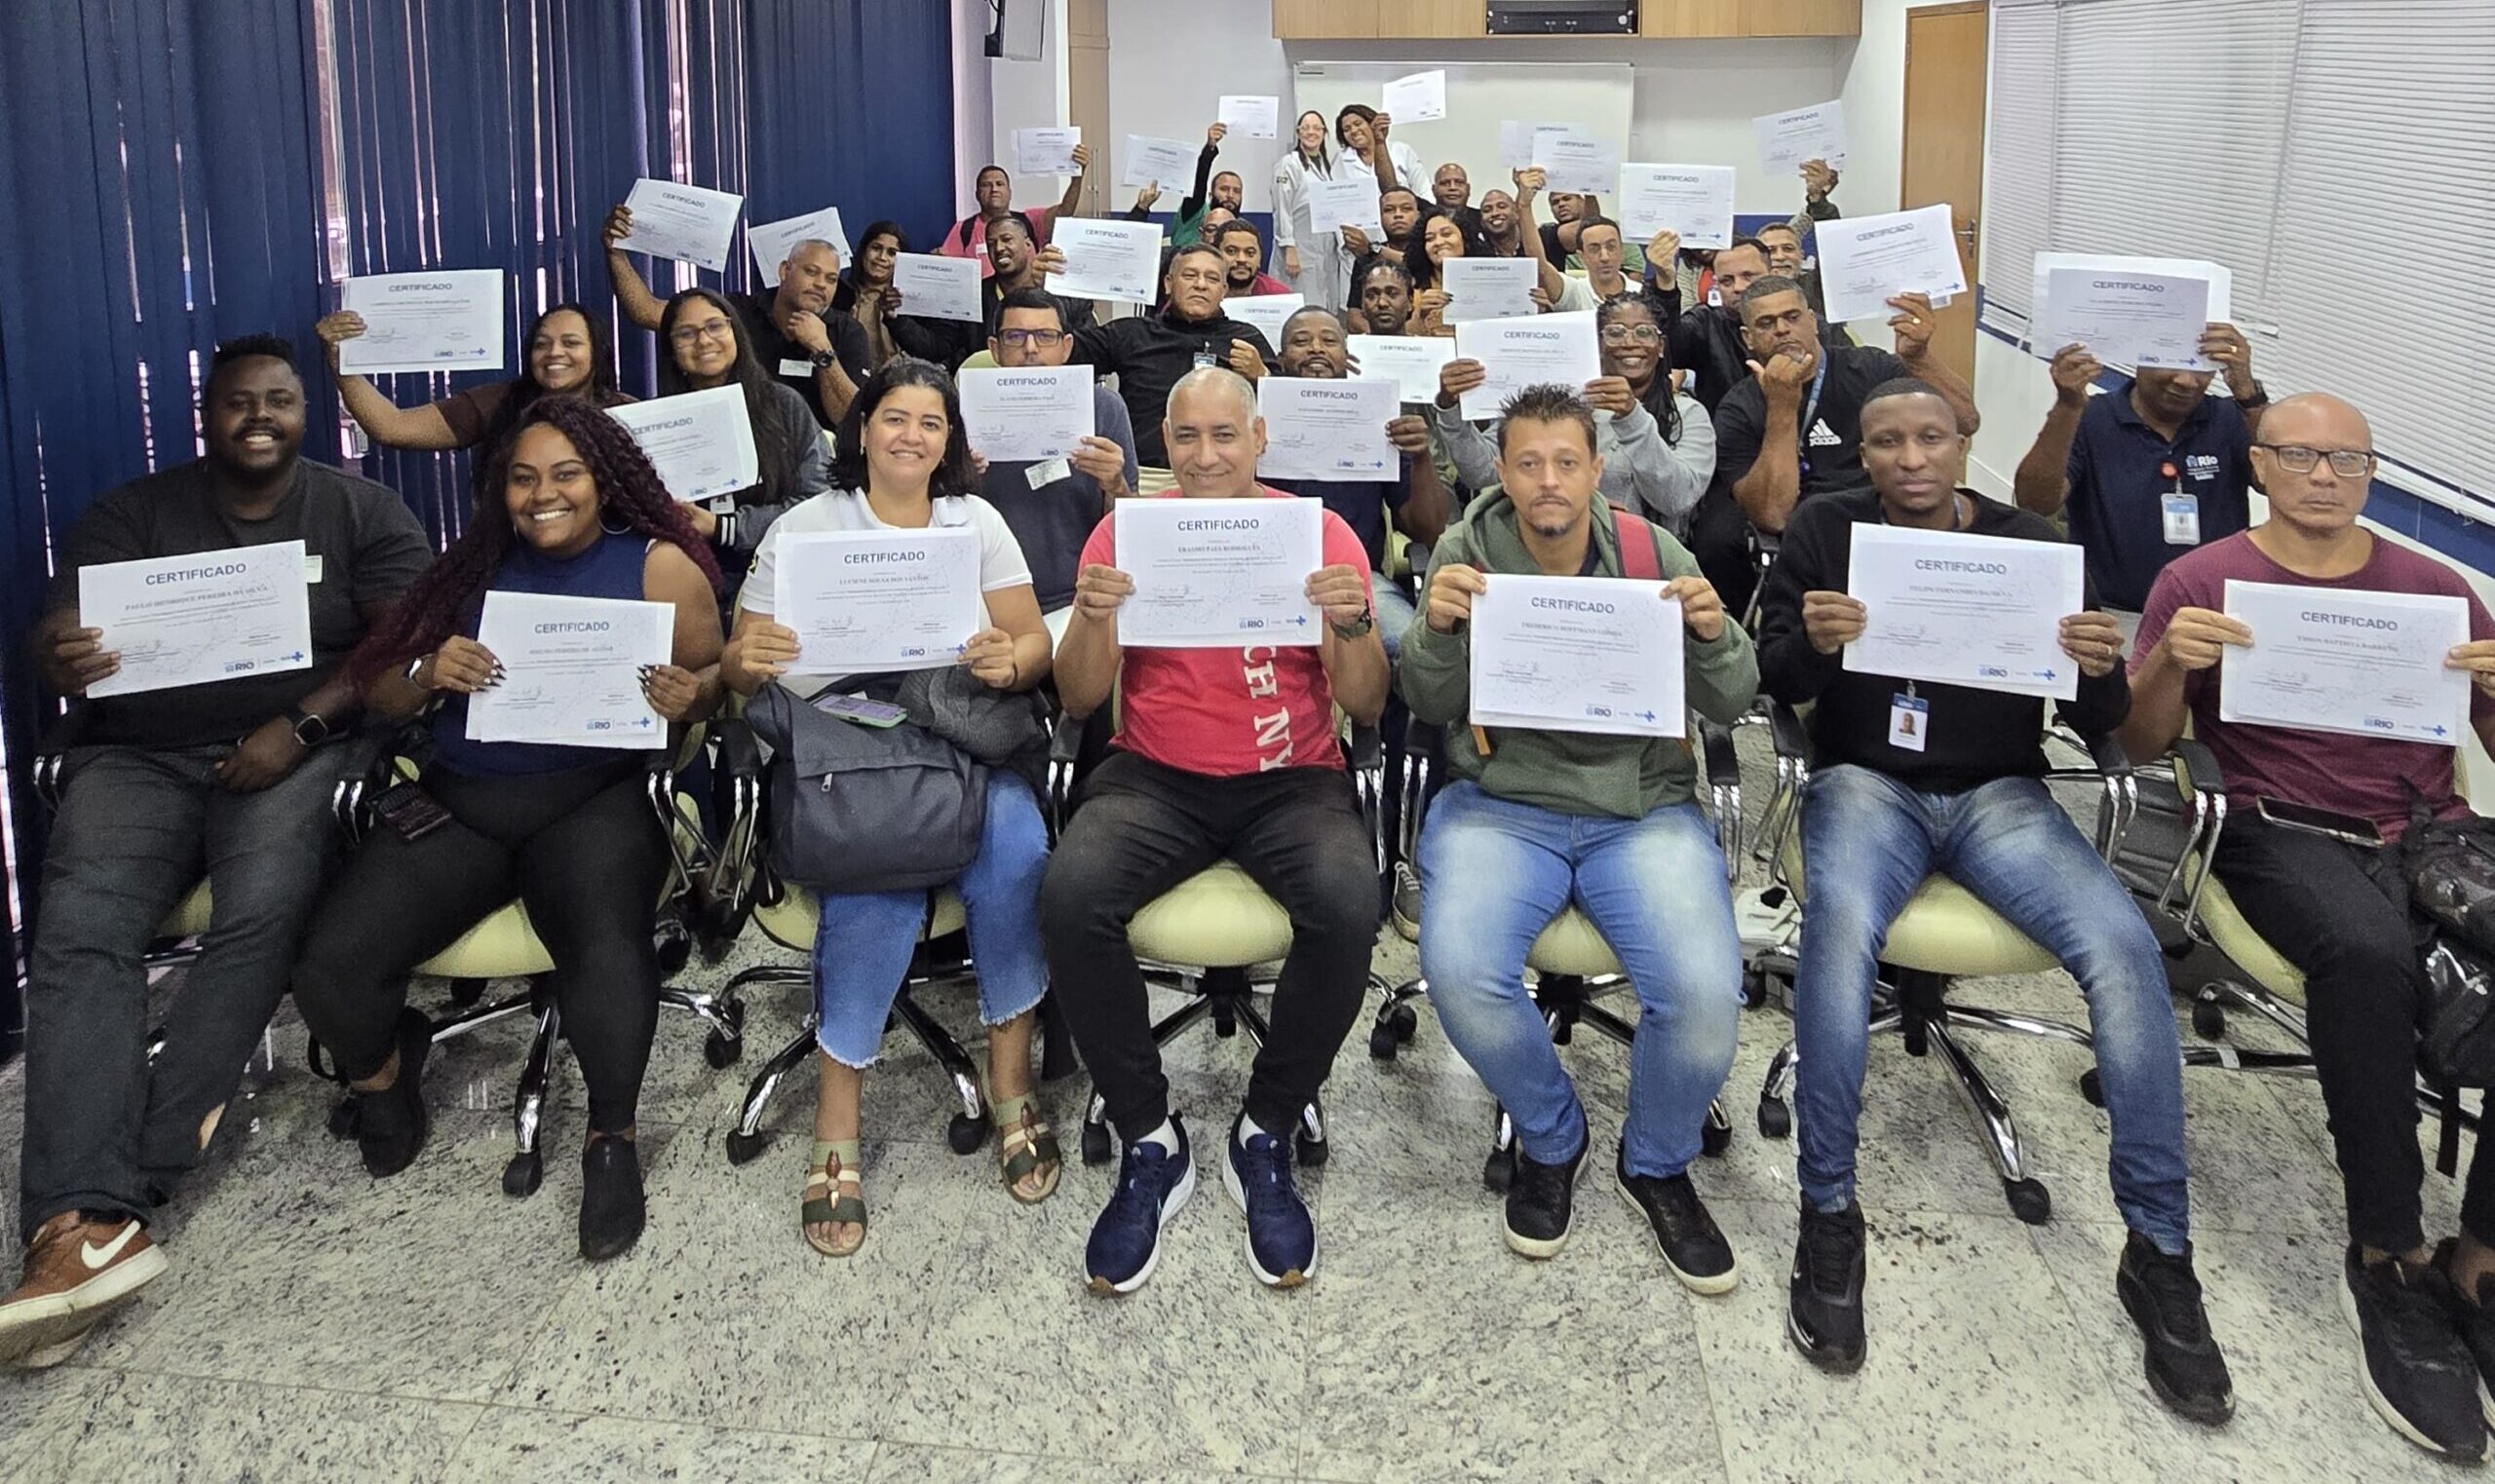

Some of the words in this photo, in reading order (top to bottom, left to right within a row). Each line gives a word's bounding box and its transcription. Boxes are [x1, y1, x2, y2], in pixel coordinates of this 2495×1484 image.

[1778, 112, 1819, 126] CERTIFICADO
[1556, 140, 1594, 149] CERTIFICADO
[1653, 174, 1700, 183] CERTIFICADO
[662, 192, 707, 209] CERTIFICADO
[1085, 228, 1129, 240] CERTIFICADO
[1856, 222, 1914, 243] CERTIFICADO
[917, 263, 953, 274] CERTIFICADO
[389, 283, 453, 293] CERTIFICADO
[2092, 280, 2165, 293] CERTIFICADO
[1504, 330, 1560, 341] CERTIFICADO
[1379, 344, 1424, 353] CERTIFICADO
[997, 377, 1057, 387] CERTIFICADO
[1300, 390, 1359, 400] CERTIFICADO
[633, 417, 694, 437] CERTIFICADO
[1177, 518, 1260, 532] CERTIFICADO
[844, 551, 926, 564] CERTIFICADO
[1914, 559, 2007, 574] CERTIFICADO
[145, 563, 247, 586] CERTIFICADO
[1531, 596, 1615, 614] CERTIFICADO
[2301, 611, 2399, 630] CERTIFICADO
[534, 622, 610, 633] CERTIFICADO
[234, 662, 254, 672] RIO
